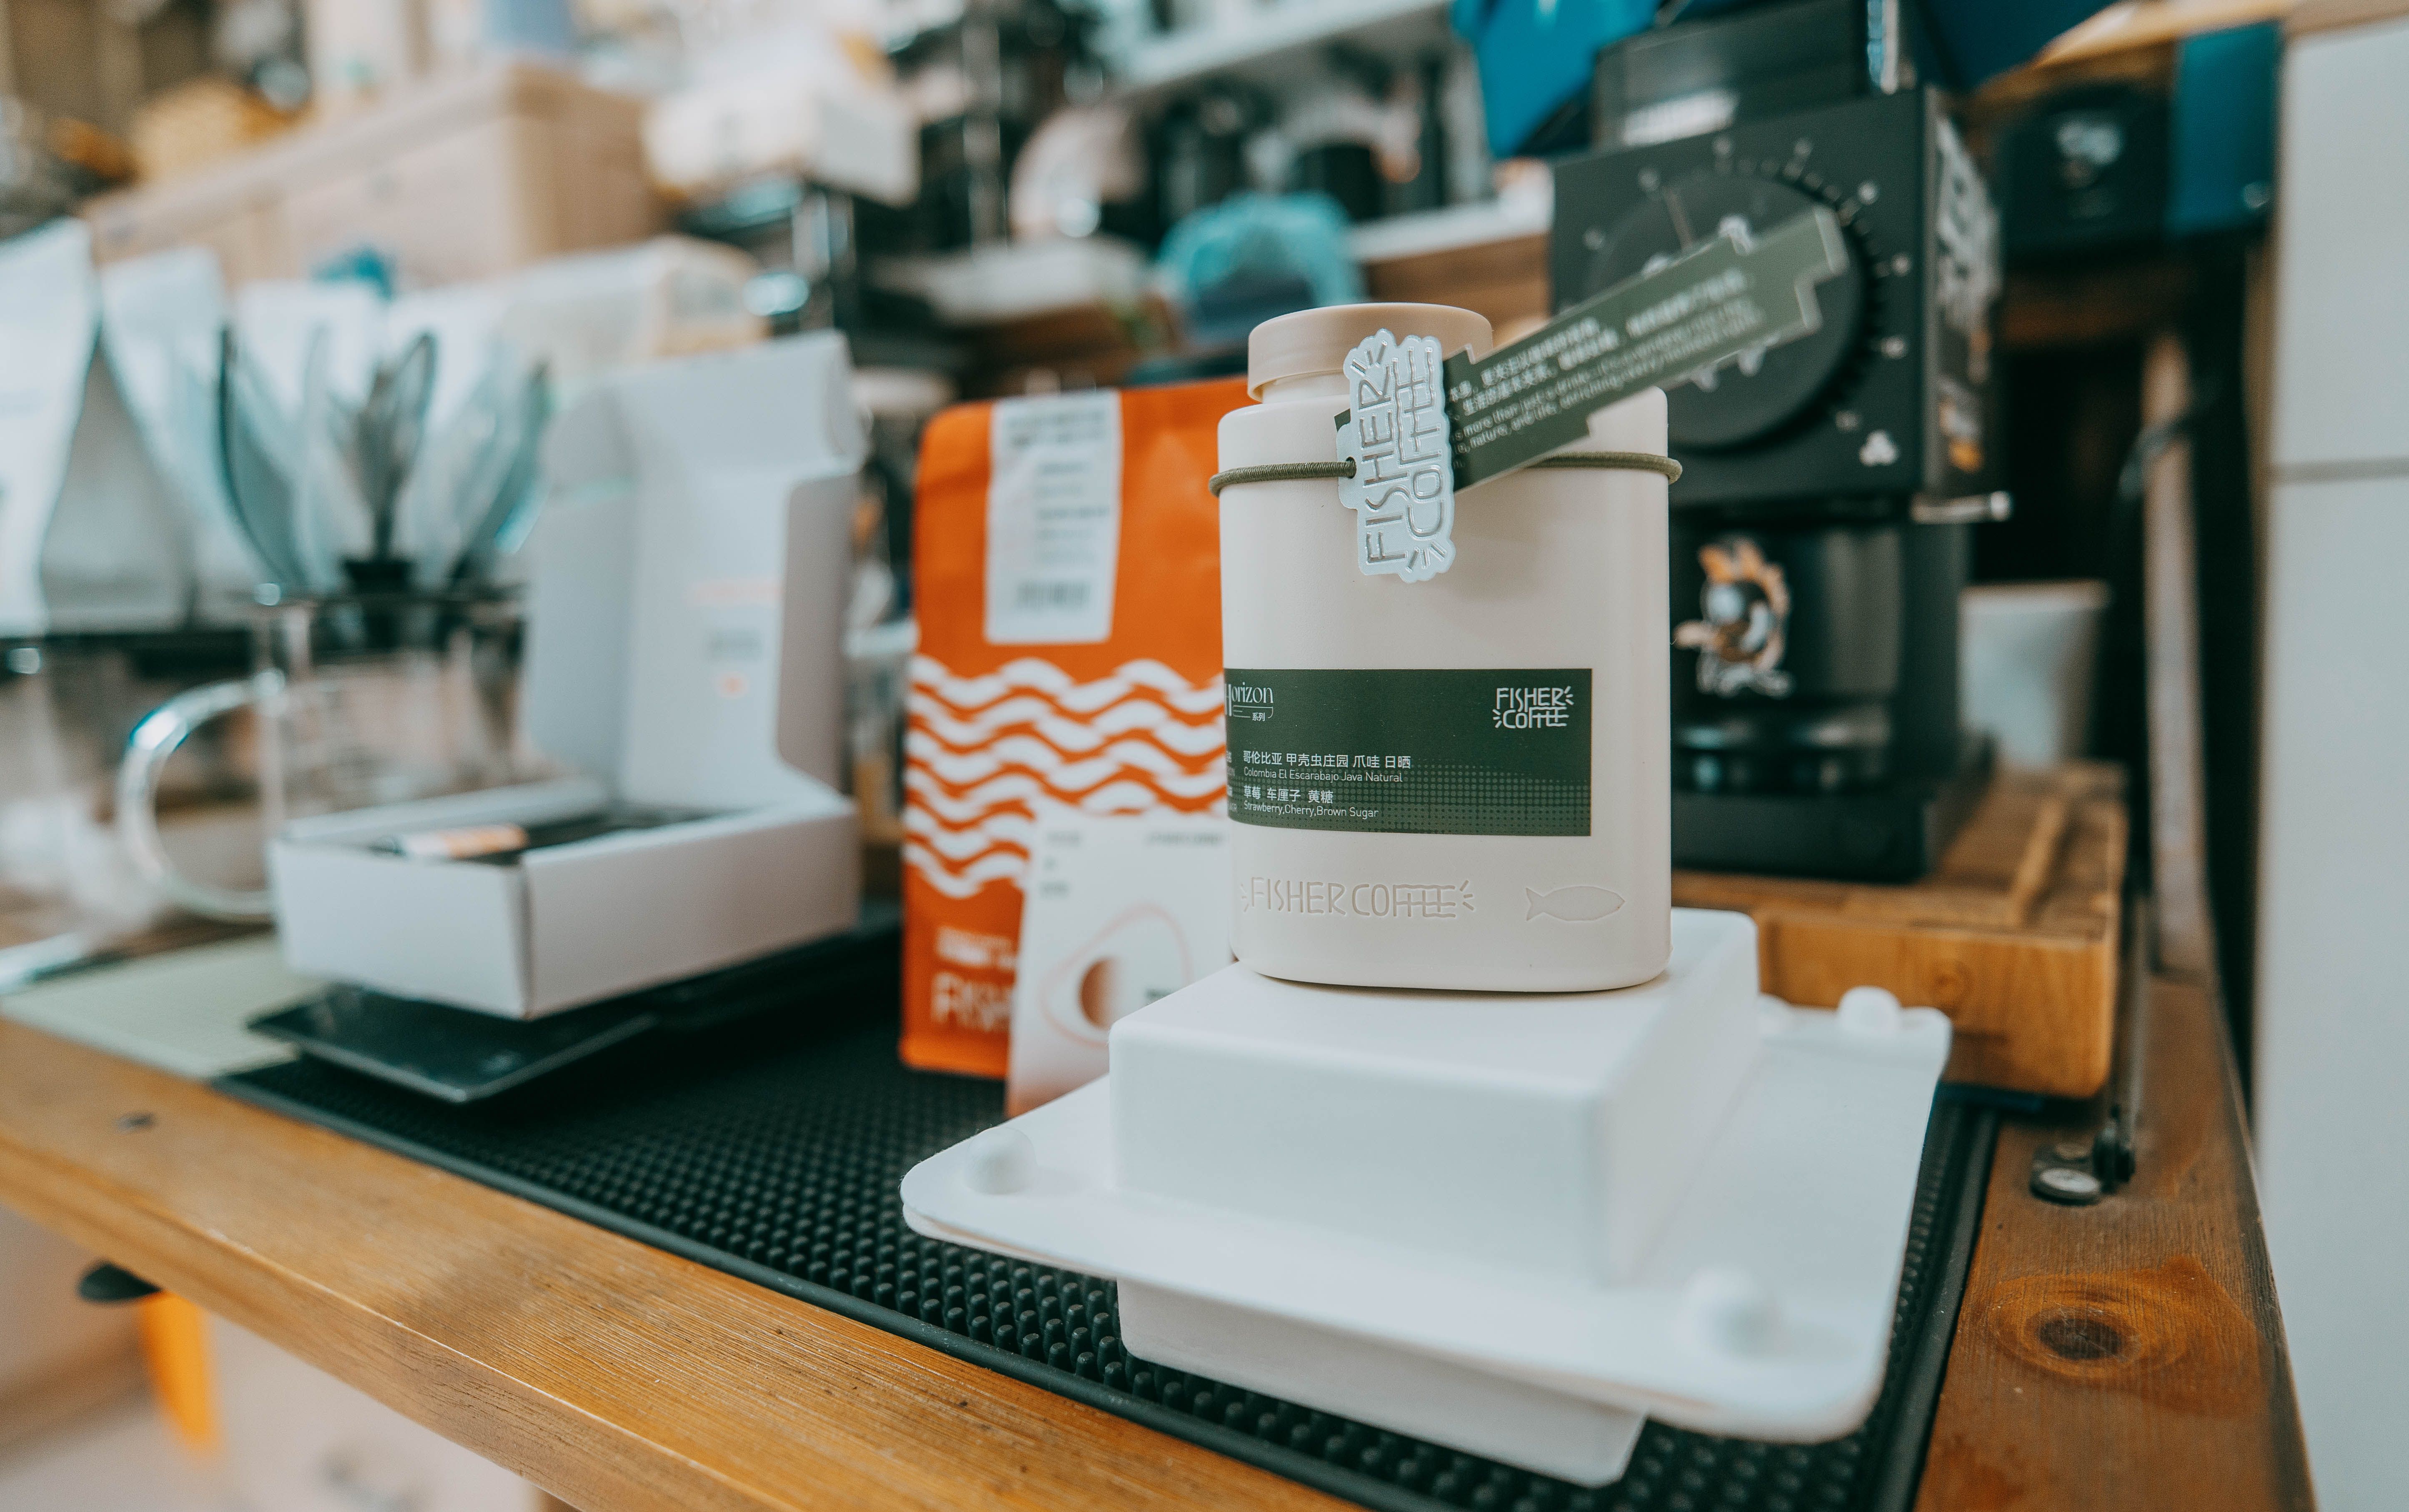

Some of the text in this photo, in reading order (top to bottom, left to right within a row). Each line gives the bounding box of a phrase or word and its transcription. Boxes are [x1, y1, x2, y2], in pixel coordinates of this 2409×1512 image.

[1358, 364, 1409, 564] FISHER
[1497, 688, 1566, 712] FISHER
[1252, 712, 1266, 722] 系列
[1243, 751, 1282, 765] 哥伦比亚
[1286, 753, 1349, 768] 甲壳虫庄园
[1353, 755, 1380, 768] 爪哇
[1385, 756, 1411, 769] 日晒
[1244, 767, 1276, 778] Colombia
[1279, 769, 1287, 779] El
[1289, 770, 1339, 783] Escarabajo
[1341, 772, 1362, 781] Java
[1366, 772, 1403, 782] Natural
[1244, 785, 1261, 799] 草莓
[1267, 788, 1301, 802] 车厘子
[1308, 790, 1334, 804] 黄糖
[1349, 807, 1379, 819] Sugar
[1251, 876, 1346, 916] FISHER
